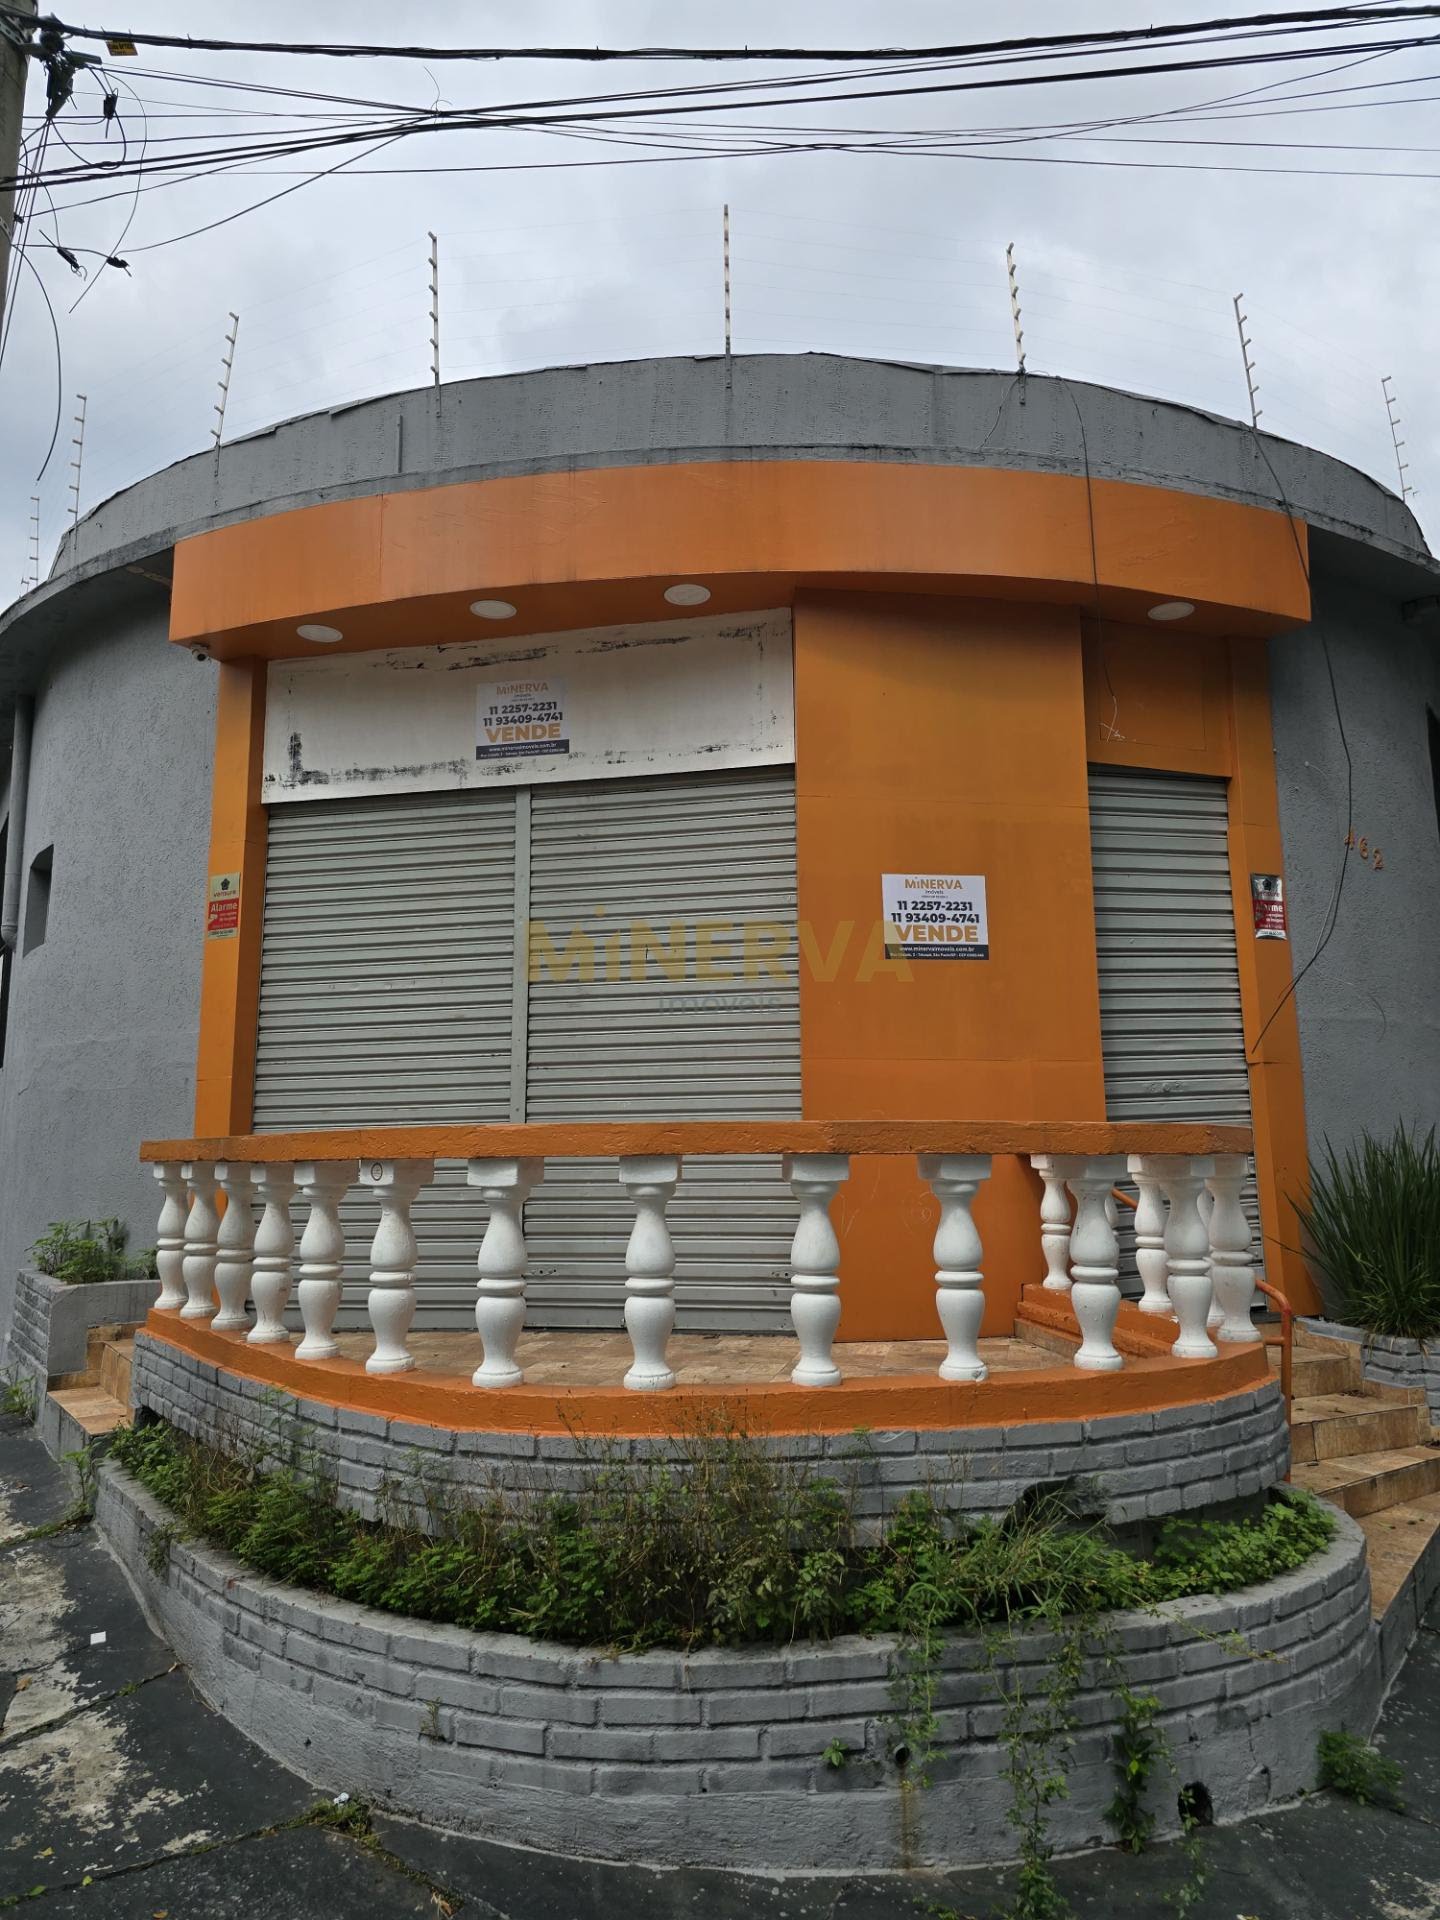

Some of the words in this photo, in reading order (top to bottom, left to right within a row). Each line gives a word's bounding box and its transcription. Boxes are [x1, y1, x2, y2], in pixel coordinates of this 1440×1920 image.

[489, 706, 498, 715] 11
[501, 701, 557, 714] 2257-2231
[483, 717, 492, 727] 11
[495, 711, 563, 726] 93409-4741
[485, 722, 561, 743] VENDE
[211, 902, 238, 913] Alarme
[897, 901, 908, 911] 11
[911, 901, 973, 911] 2257-2231
[891, 913, 902, 923] 11
[905, 912, 980, 924] 93409-4741
[894, 924, 979, 943] VENDE
